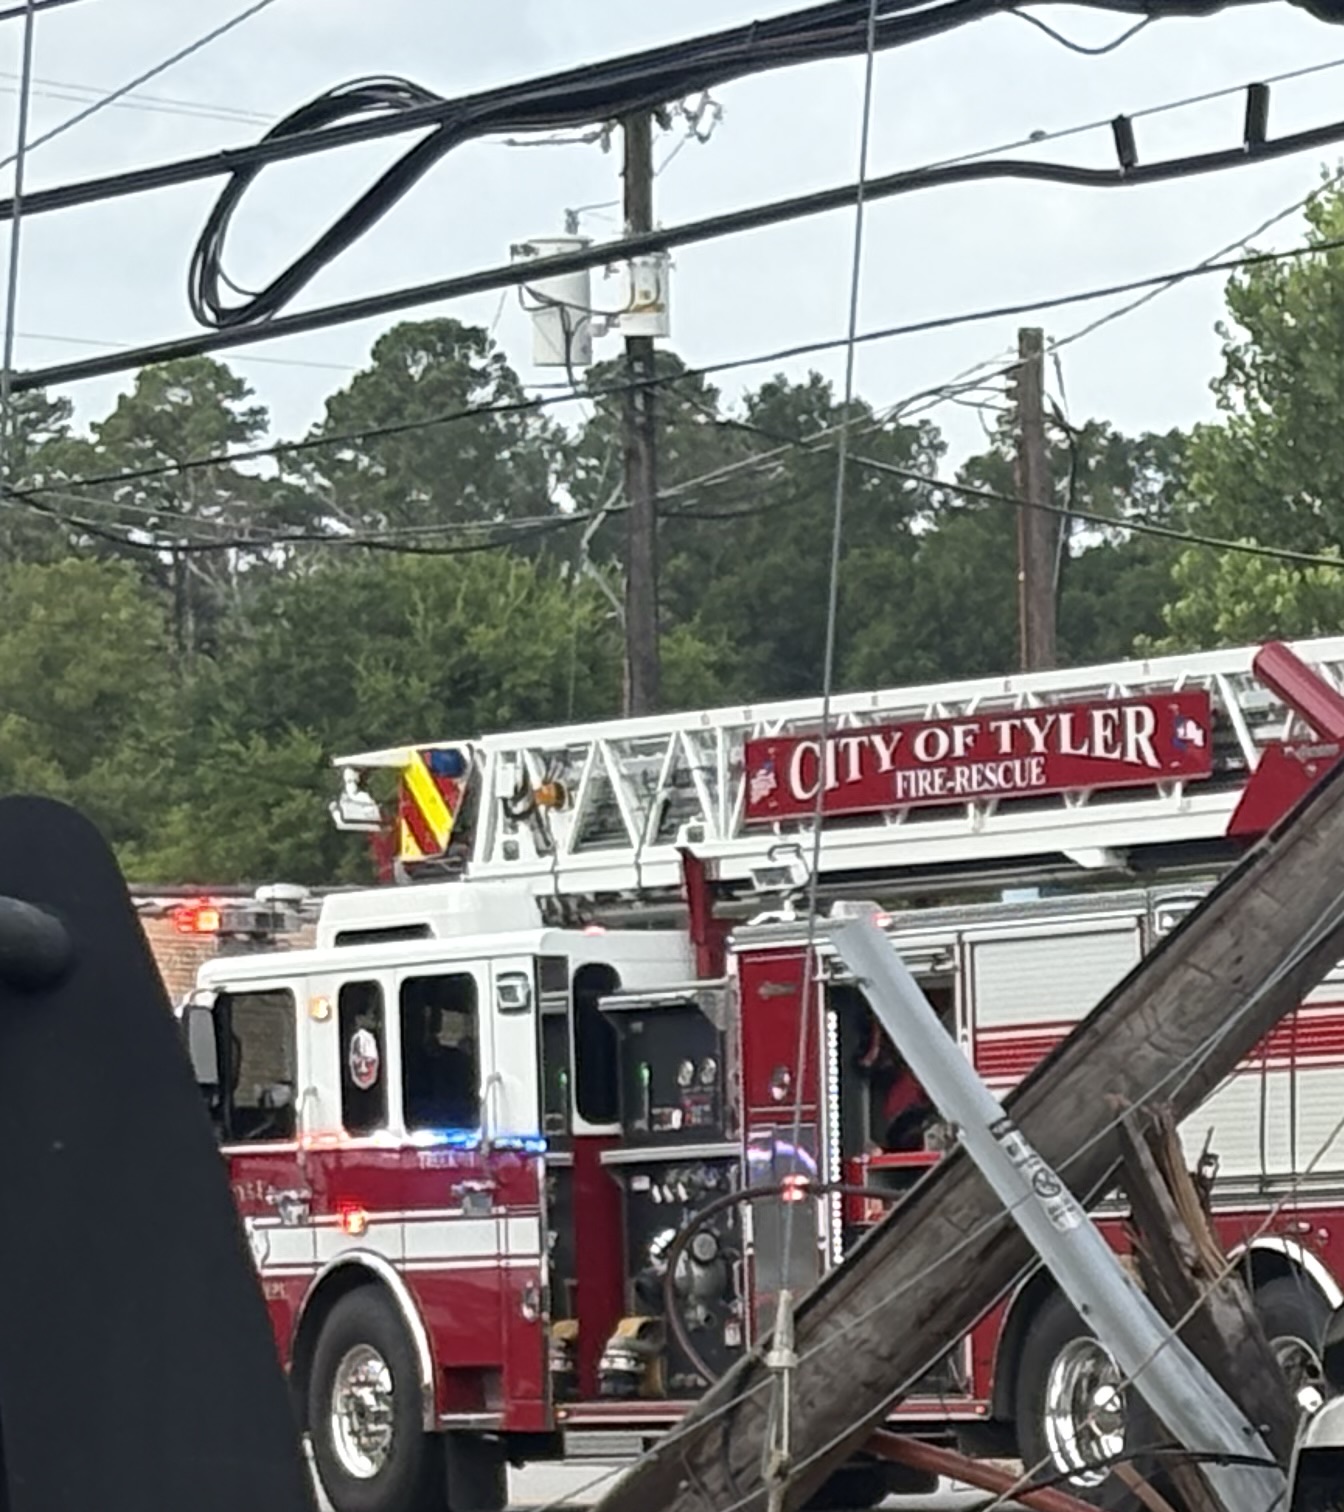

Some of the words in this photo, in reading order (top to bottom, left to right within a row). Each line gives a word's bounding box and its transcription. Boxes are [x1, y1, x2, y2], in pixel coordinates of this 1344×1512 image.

[789, 729, 903, 801] CITY
[913, 723, 981, 763] OF
[990, 704, 1162, 769] TYLER
[895, 756, 1047, 800] FIRE-RESCUE
